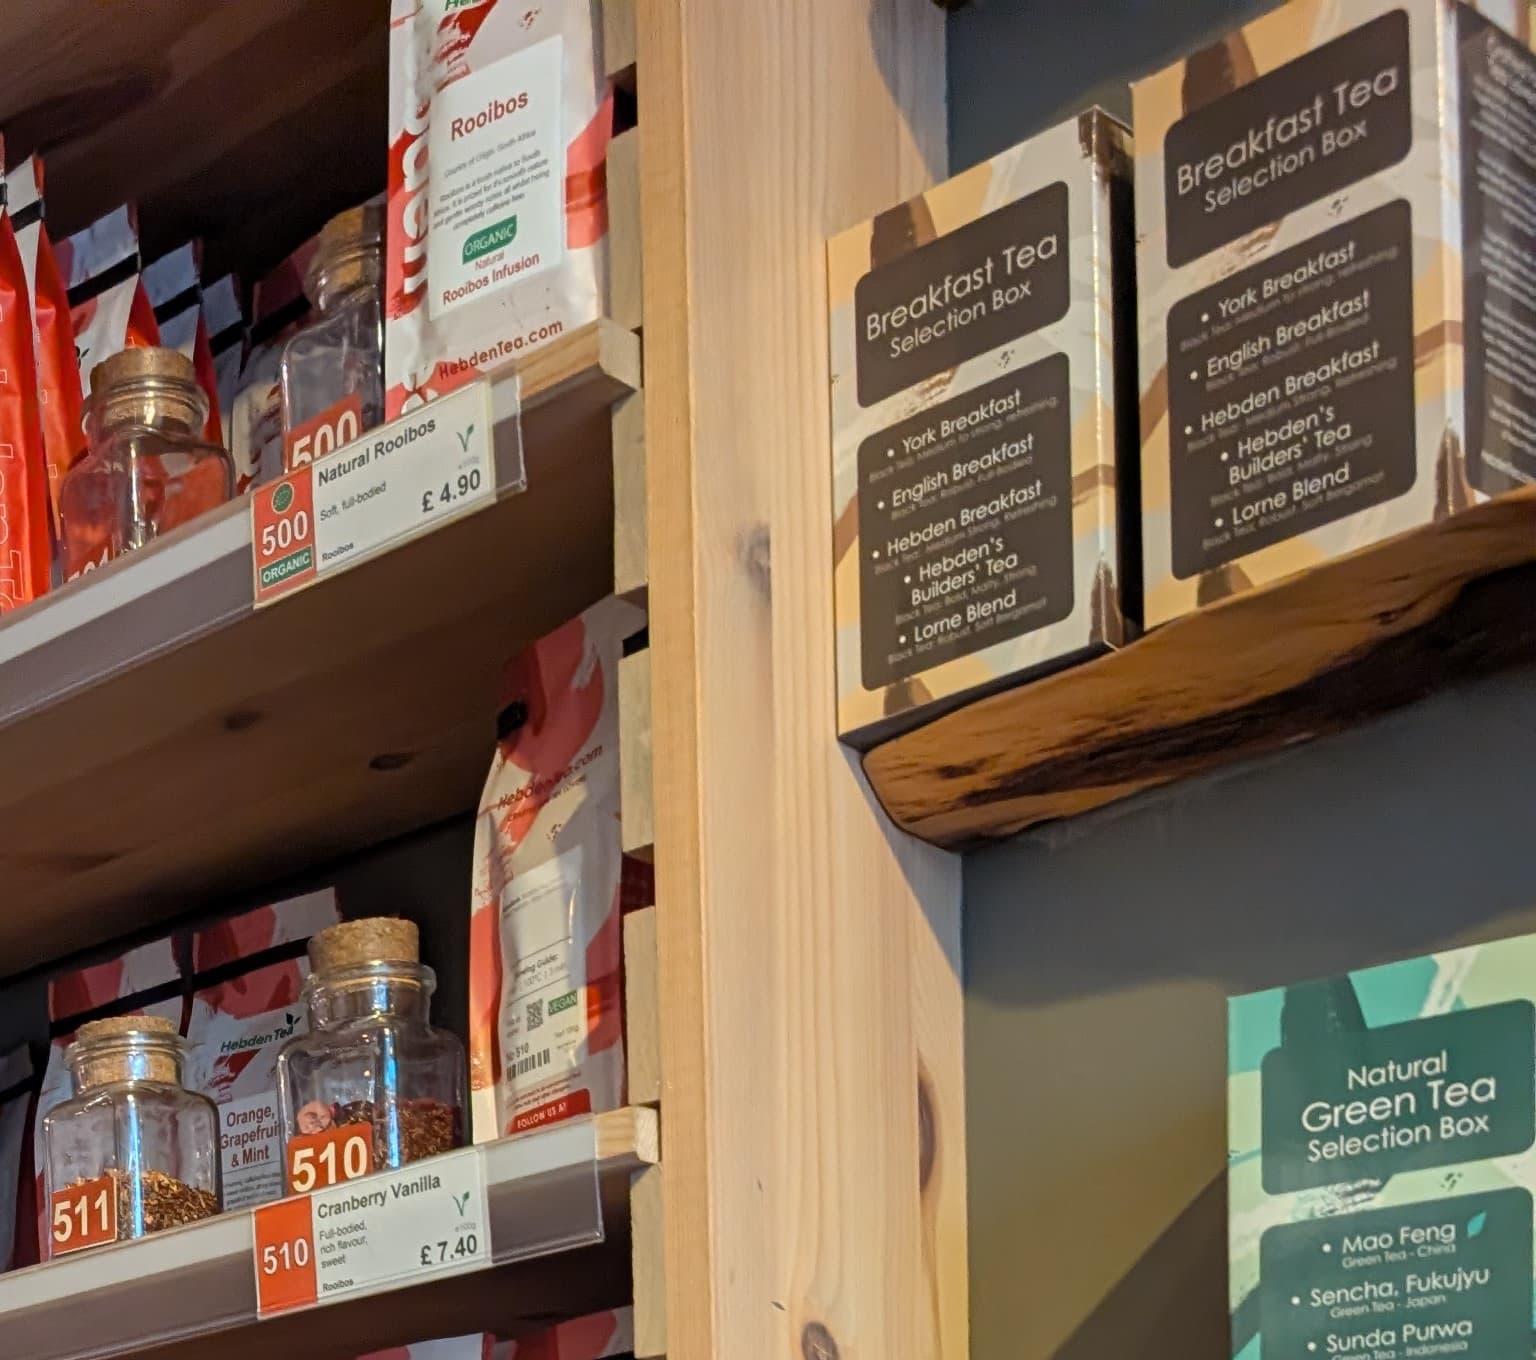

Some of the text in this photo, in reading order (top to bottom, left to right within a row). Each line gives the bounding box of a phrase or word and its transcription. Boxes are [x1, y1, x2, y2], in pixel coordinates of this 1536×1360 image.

[450, 89, 528, 141] Rooibos
[1177, 66, 1398, 195] Breakfast Tea
[1204, 120, 1368, 213] Selection Box
[464, 223, 515, 256] ORGANIC
[442, 251, 540, 305] Rooibos Infusion
[1217, 243, 1355, 320] York Breakfast
[439, 318, 563, 379] HebdenTea.com
[1206, 290, 1371, 379] English Breakfast
[1200, 341, 1380, 433] Hebden Breakfast
[317, 417, 436, 486] Natural Rooibos
[1314, 422, 1351, 450] Tea
[422, 469, 482, 514] £ 4.90
[1231, 462, 1350, 527] Lorne Blend
[261, 518, 309, 558] 500
[262, 549, 311, 584] ORGANIC
[1346, 1050, 1448, 1090] Natural
[1301, 1075, 1497, 1133] Green Tea
[1307, 1113, 1490, 1162] Selection Box
[292, 1136, 367, 1192] 510
[52, 1198, 112, 1244] 511
[317, 1173, 441, 1220] Cranberry Vanilla
[262, 1237, 309, 1277] 510
[420, 1234, 477, 1265] £ 7.40
[1342, 1221, 1456, 1253] Mao Feng
[1326, 1328, 1395, 1353] Sunda
